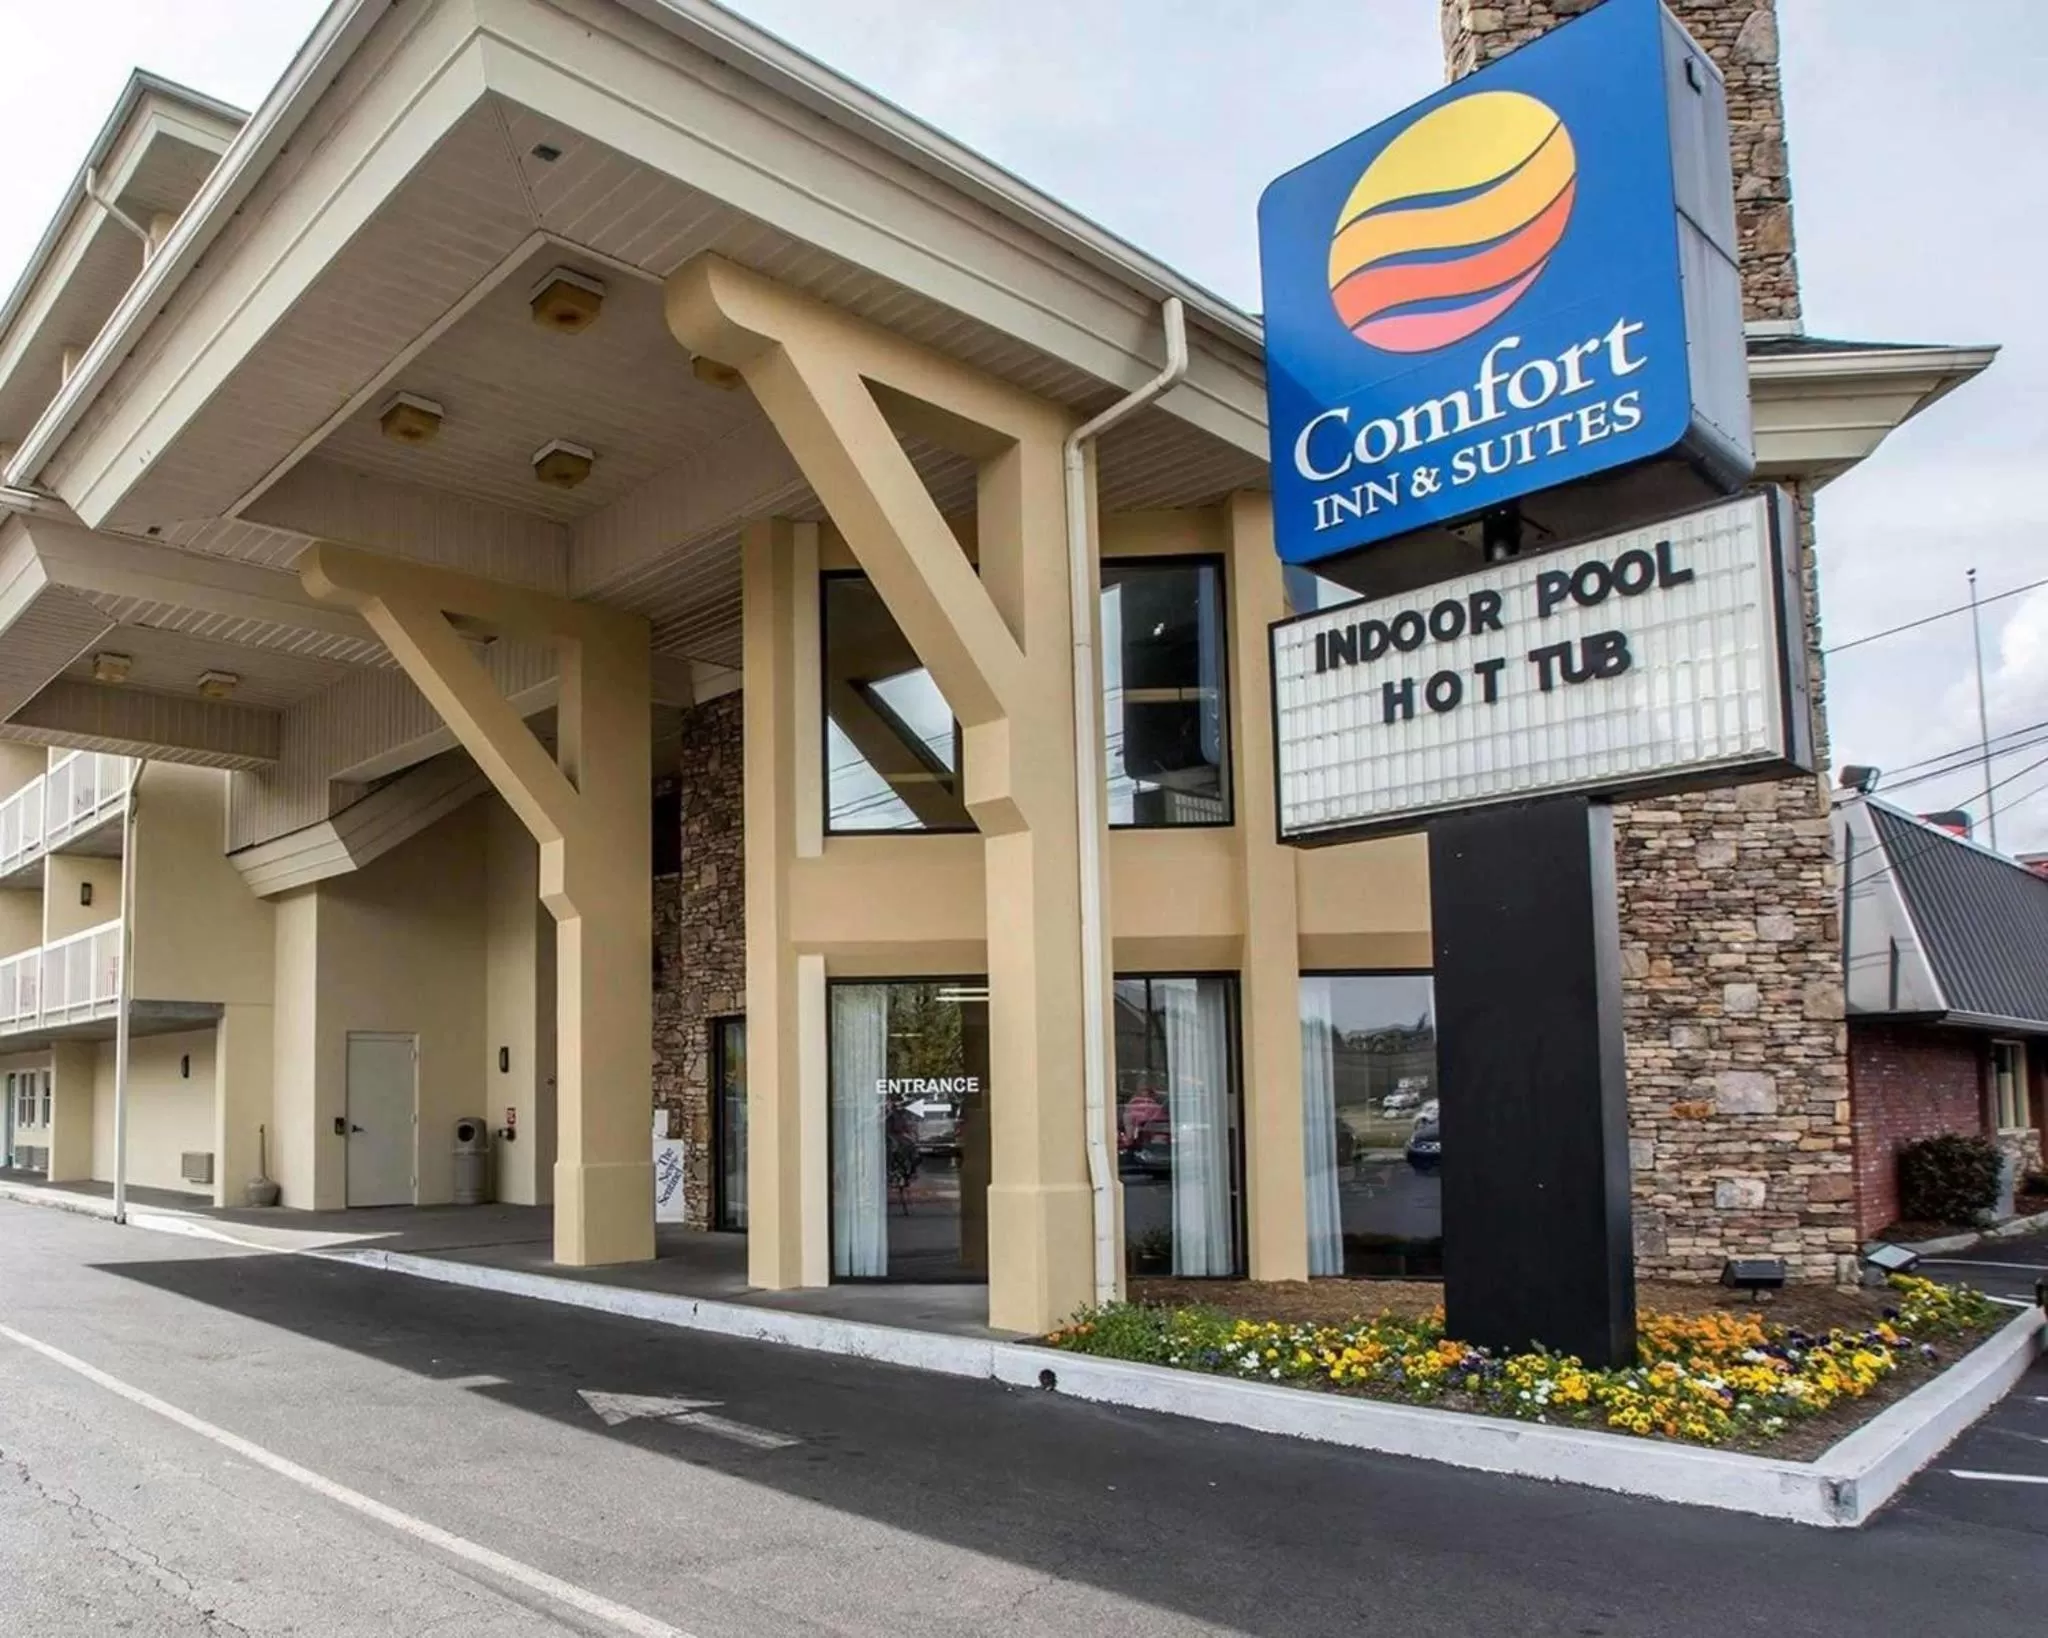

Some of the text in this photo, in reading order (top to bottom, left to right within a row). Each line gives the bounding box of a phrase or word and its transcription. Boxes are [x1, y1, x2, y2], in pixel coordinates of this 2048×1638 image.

[1294, 316, 1649, 482] Comfort
[1313, 390, 1643, 533] INN & SUITES
[1315, 540, 1694, 674] INDOOR POOL
[1382, 630, 1632, 724] HOT TUB
[876, 1077, 980, 1094] ENTRANCE
[658, 1147, 675, 1167] The
[658, 1166, 684, 1207] Sentinel
